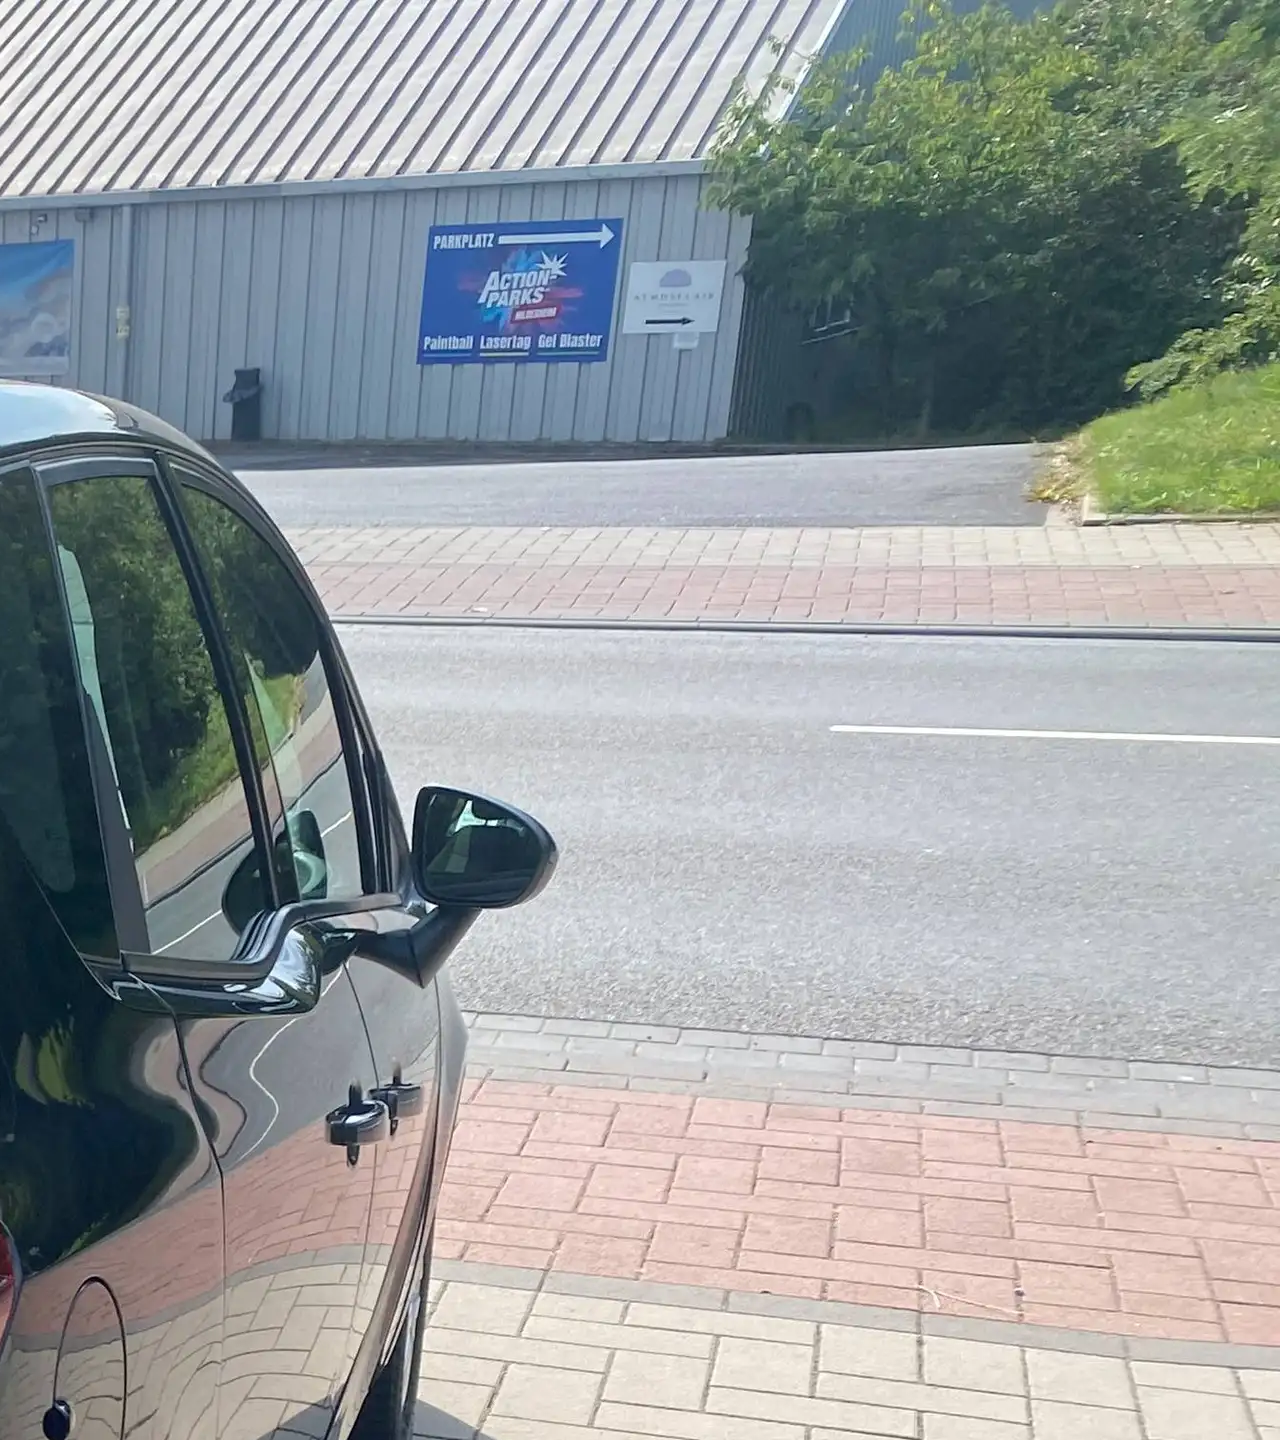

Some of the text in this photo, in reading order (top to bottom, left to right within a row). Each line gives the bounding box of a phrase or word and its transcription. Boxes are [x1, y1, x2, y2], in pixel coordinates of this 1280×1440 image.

[433, 233, 495, 250] PARKPLATZ
[477, 269, 557, 304] ACTION-
[485, 286, 546, 308] PARKS
[423, 335, 474, 350] Paintball
[479, 335, 532, 351] Lasertag
[537, 333, 603, 348] Gel Blaster
